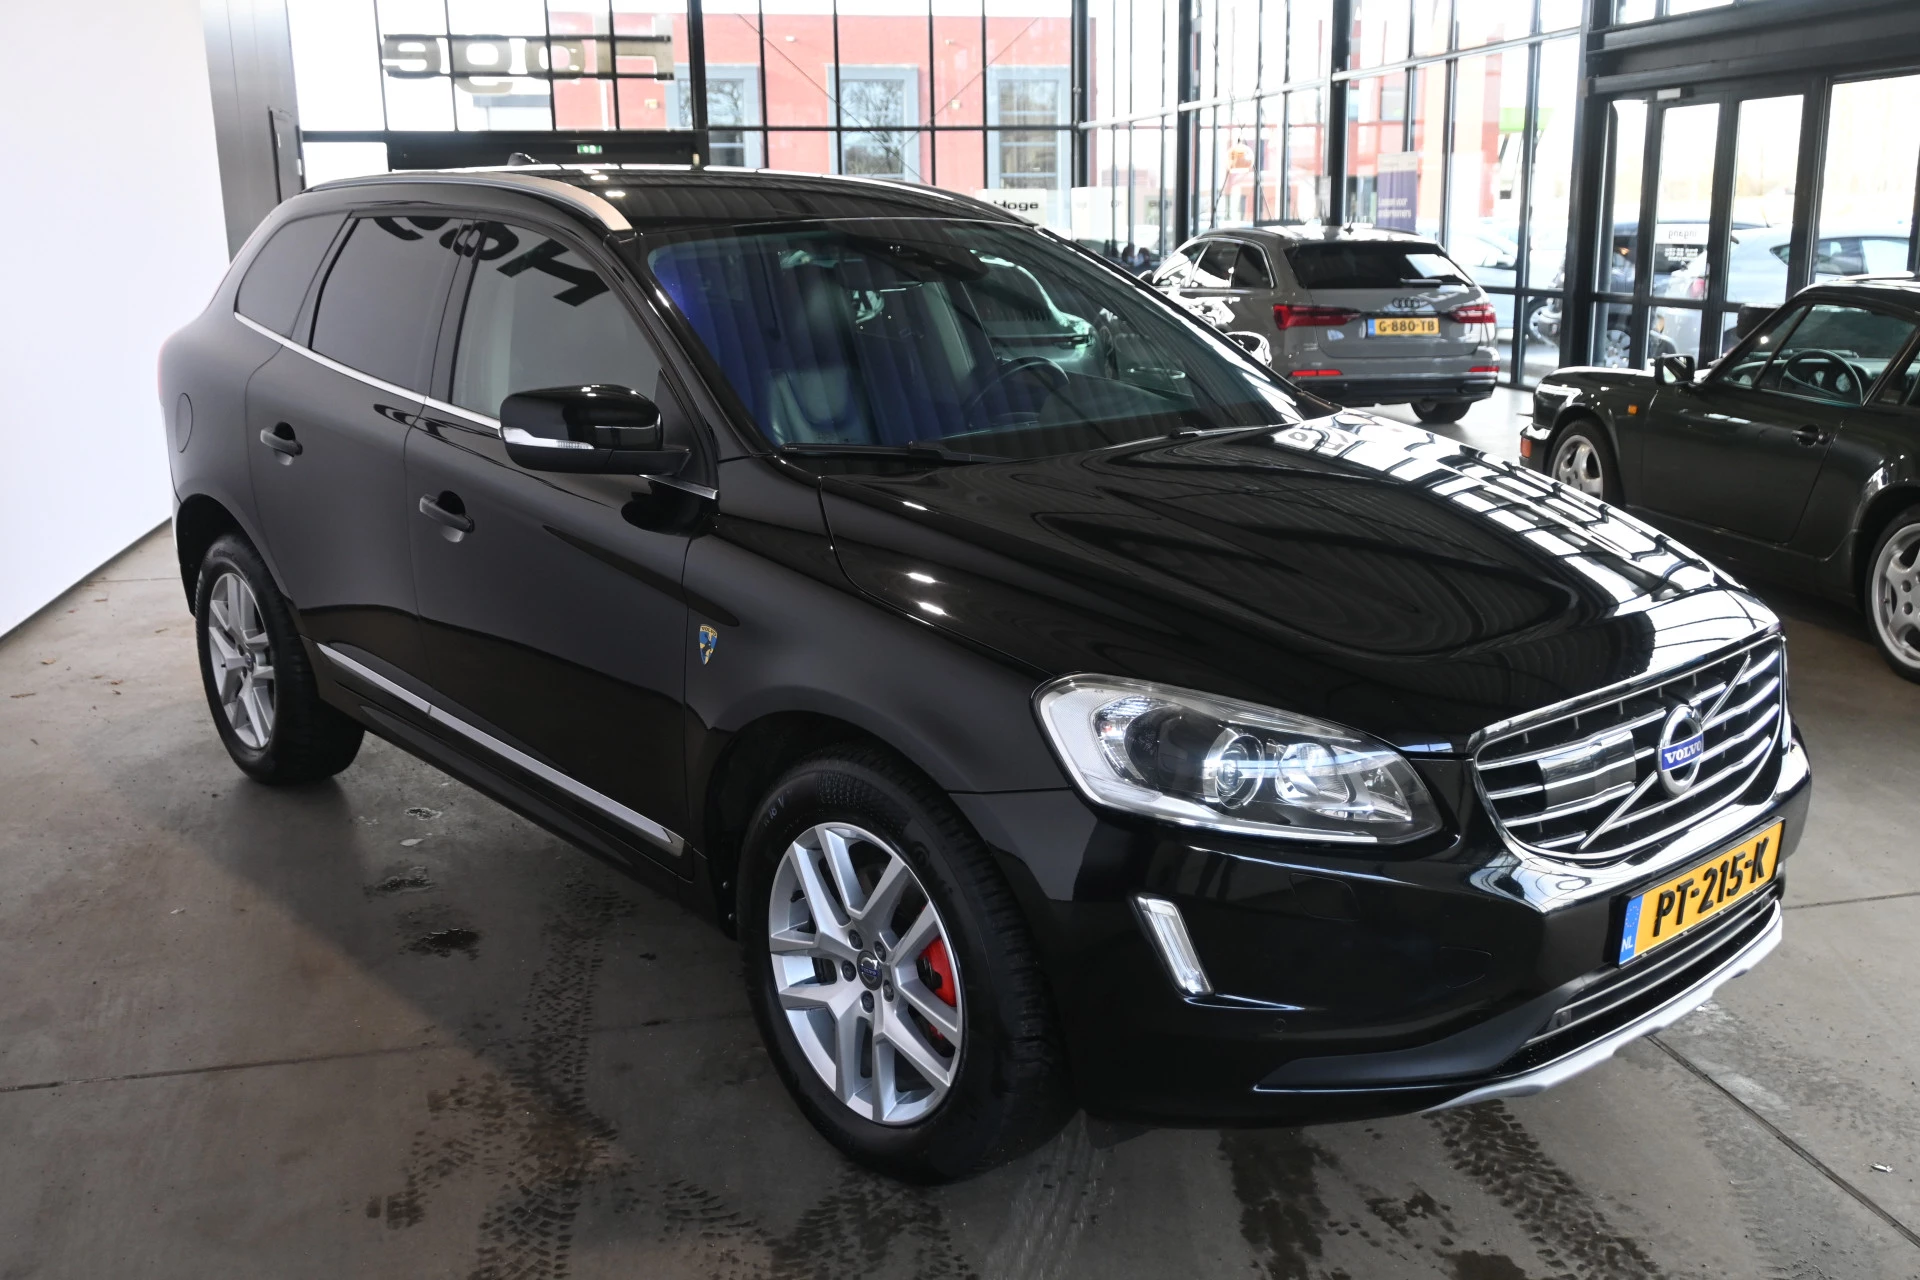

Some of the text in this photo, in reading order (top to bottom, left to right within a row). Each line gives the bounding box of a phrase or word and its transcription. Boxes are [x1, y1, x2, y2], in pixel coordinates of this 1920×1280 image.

[1378, 319, 1435, 332] G-880-TB
[1664, 740, 1702, 764] VOLVO
[1652, 836, 1770, 938] PT-215-K
[1621, 935, 1634, 953] NL
